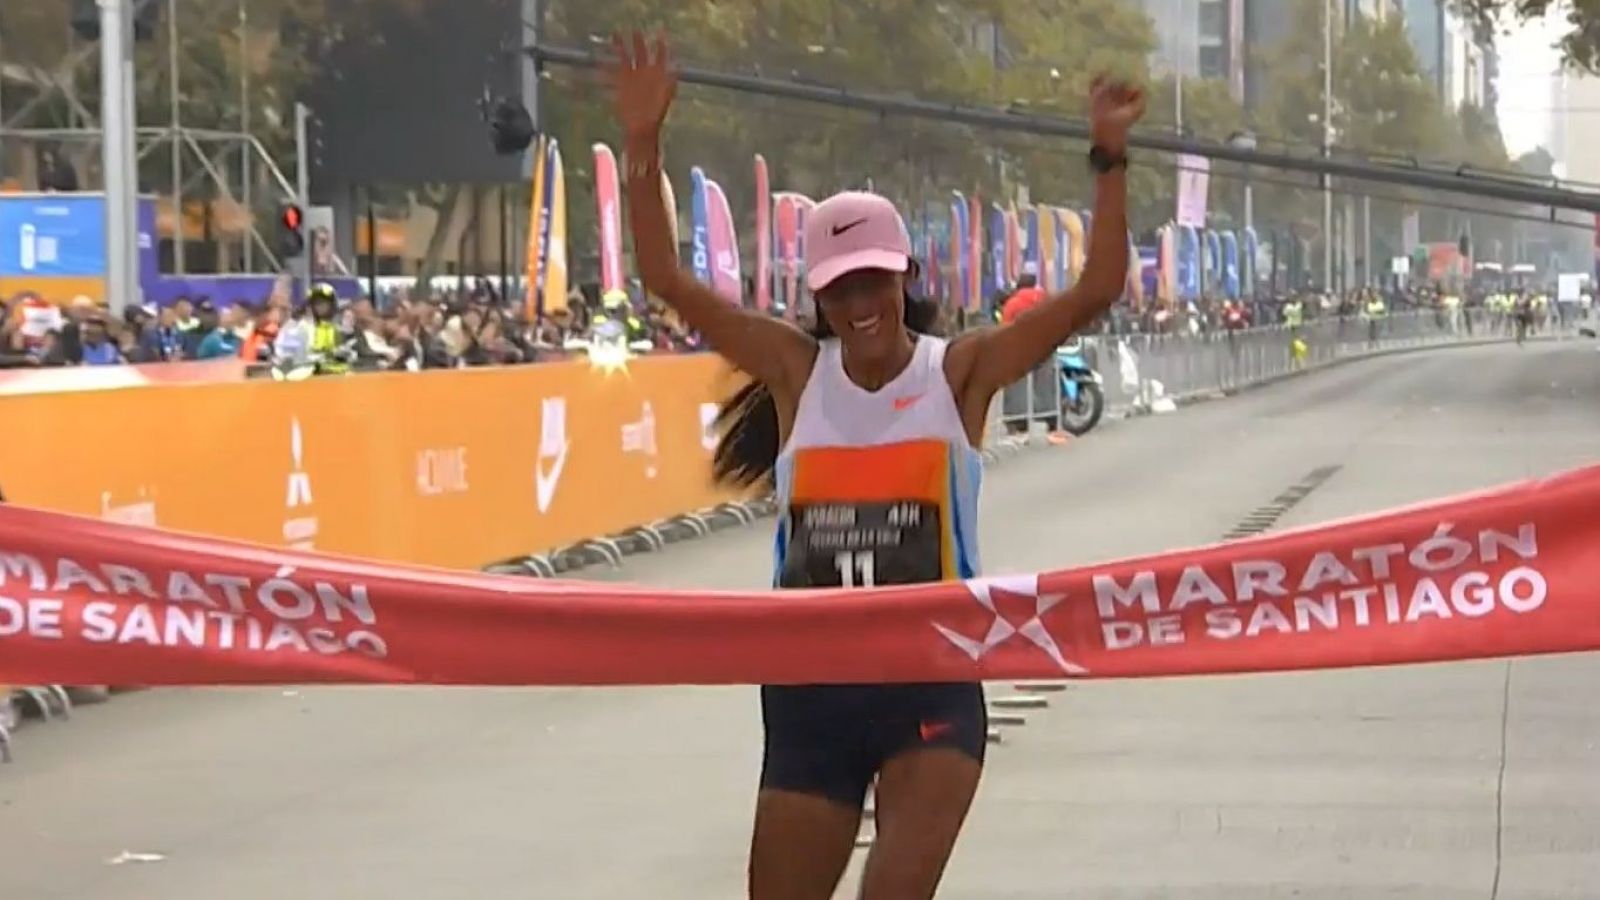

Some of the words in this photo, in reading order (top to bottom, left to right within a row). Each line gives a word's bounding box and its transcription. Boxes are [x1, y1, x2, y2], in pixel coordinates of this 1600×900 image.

[0, 552, 377, 625] MARATÓN
[834, 550, 875, 588] 11
[1092, 522, 1538, 617] MARATÓN
[81, 601, 388, 658] SANTIAGO
[1101, 613, 1186, 650] DE
[1204, 567, 1548, 640] SANTIAGO
